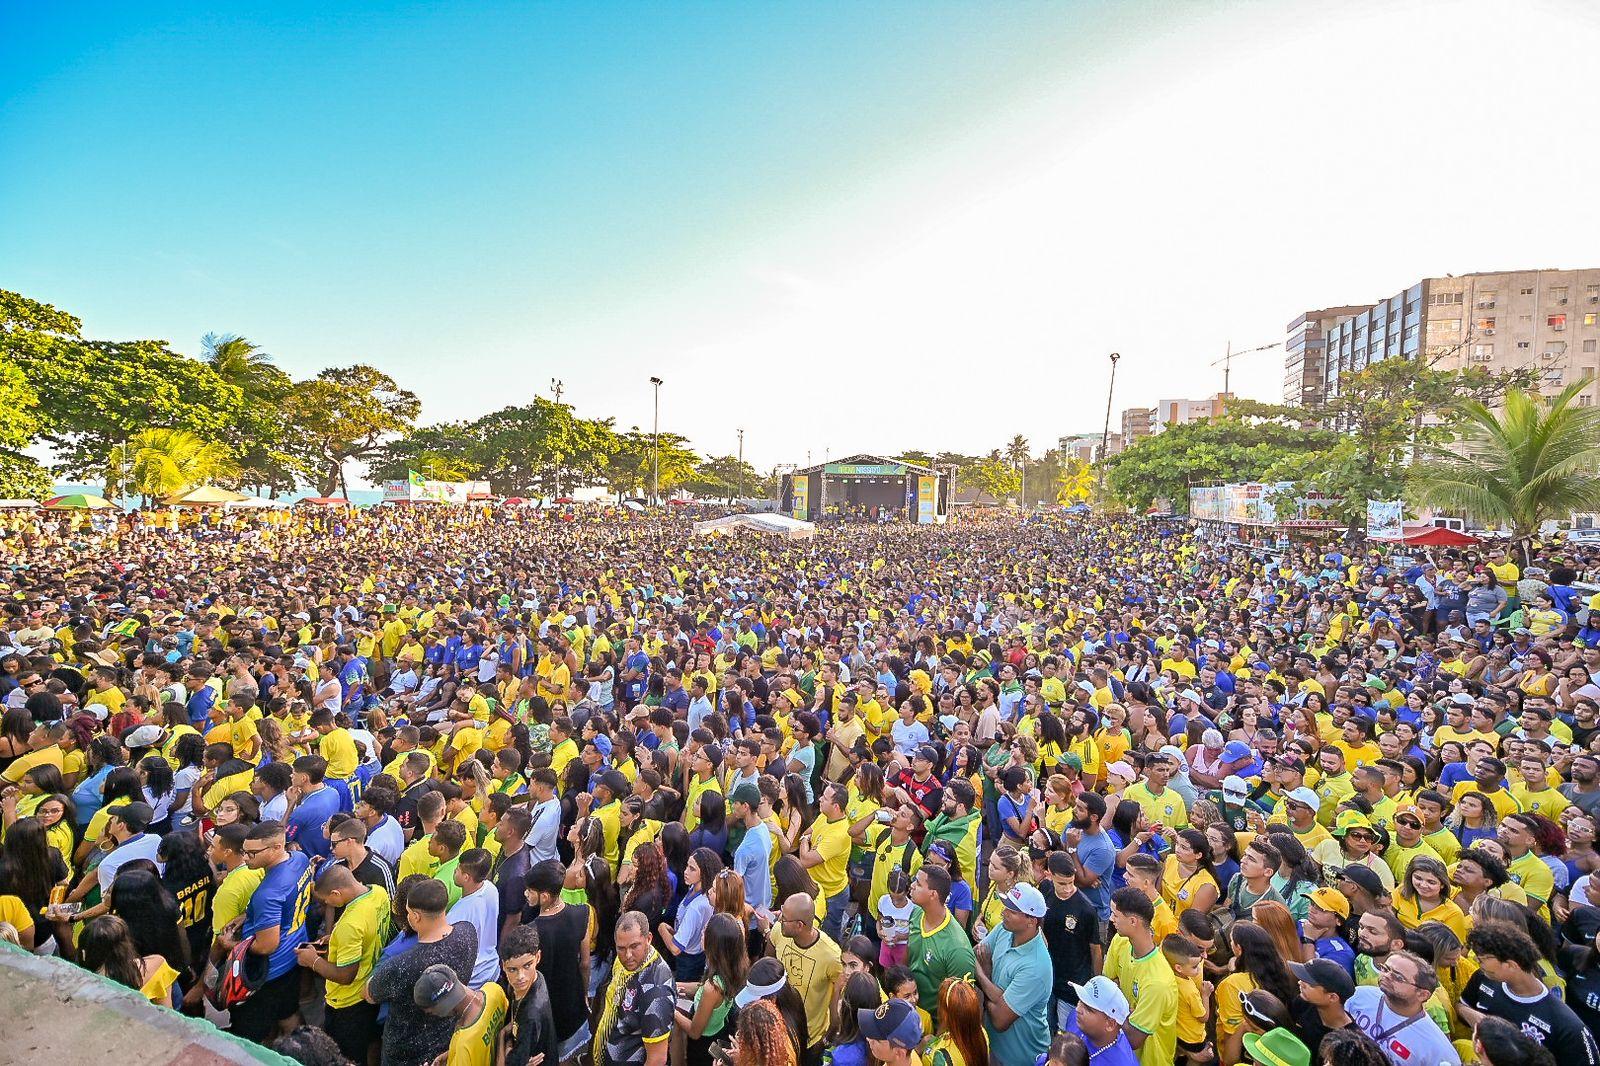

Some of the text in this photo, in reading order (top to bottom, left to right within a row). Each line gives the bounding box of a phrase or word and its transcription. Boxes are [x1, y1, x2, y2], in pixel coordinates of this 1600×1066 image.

[176, 876, 210, 900] BRASIL
[184, 890, 207, 928] 10
[482, 1006, 503, 1047] BRASIL
